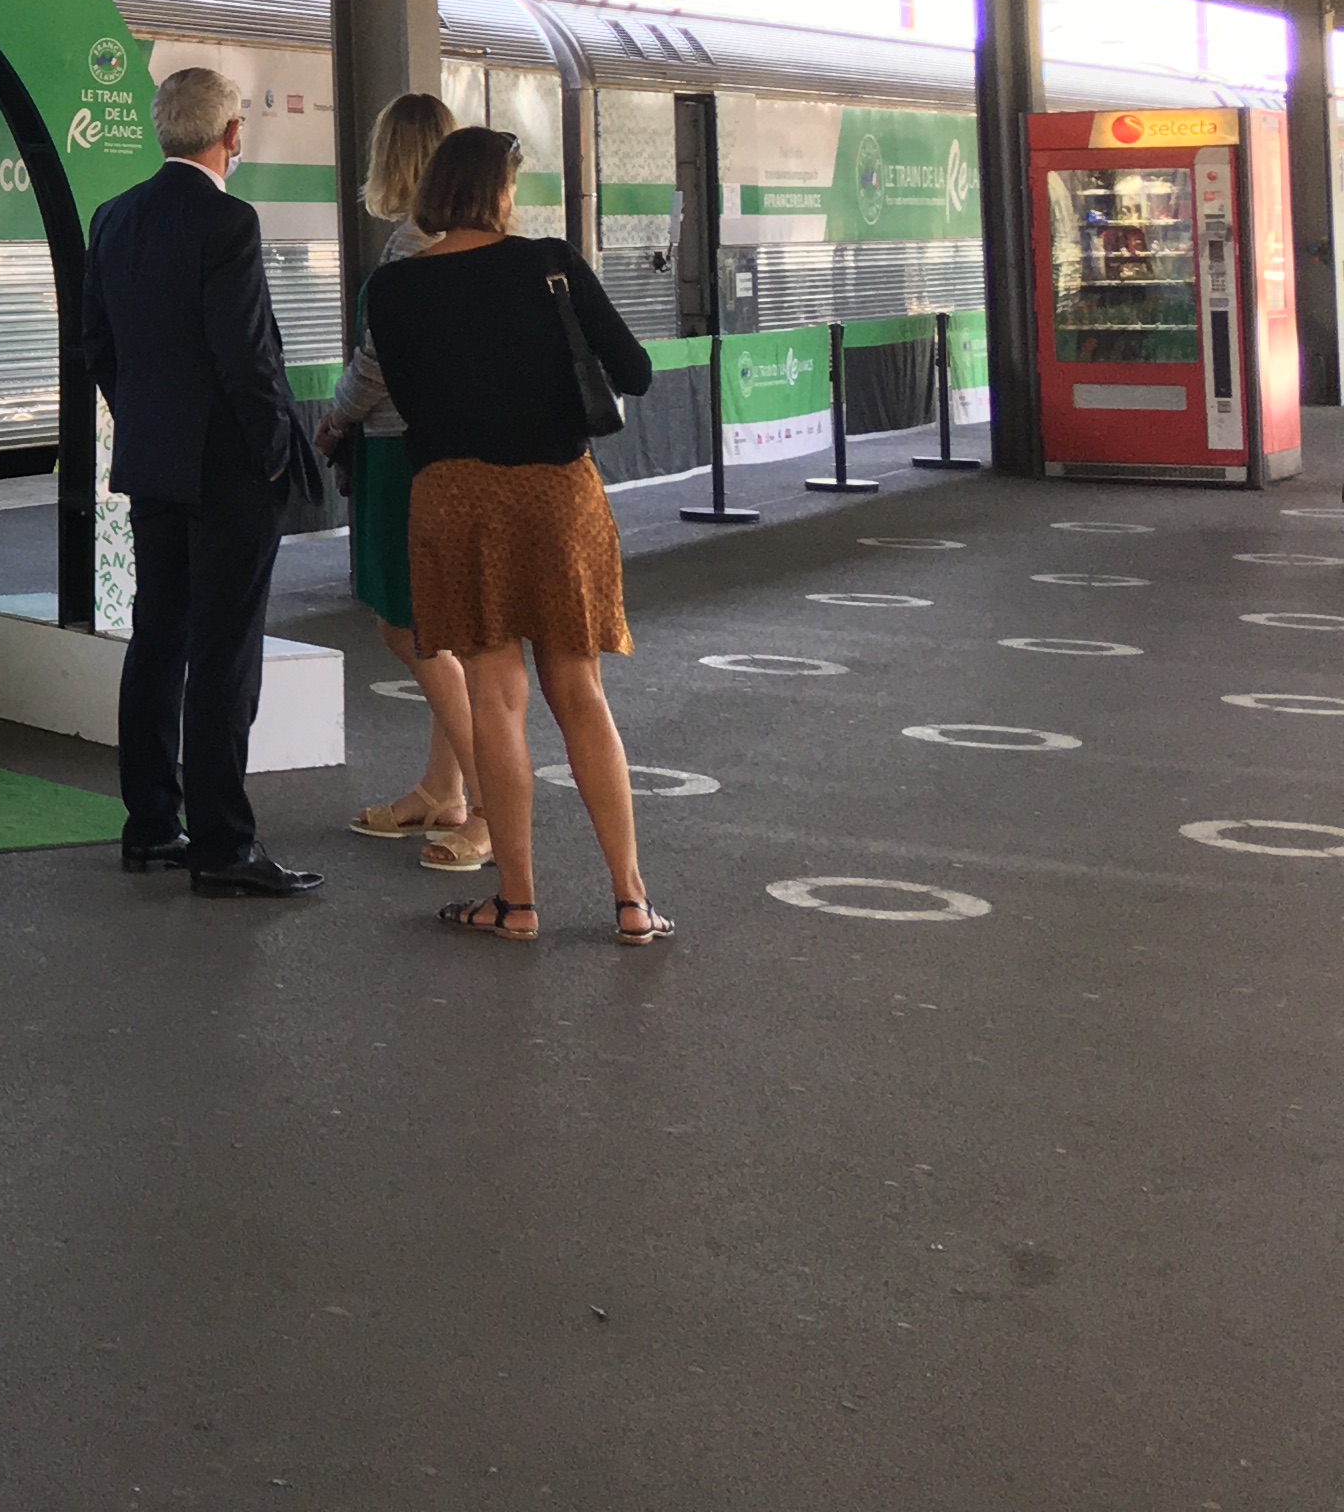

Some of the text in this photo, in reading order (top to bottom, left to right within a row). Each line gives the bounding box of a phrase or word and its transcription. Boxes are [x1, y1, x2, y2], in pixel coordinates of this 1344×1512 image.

[81, 89, 133, 104] LE TRAIN
[105, 107, 138, 122] DE LA
[1147, 118, 1218, 137] selecta
